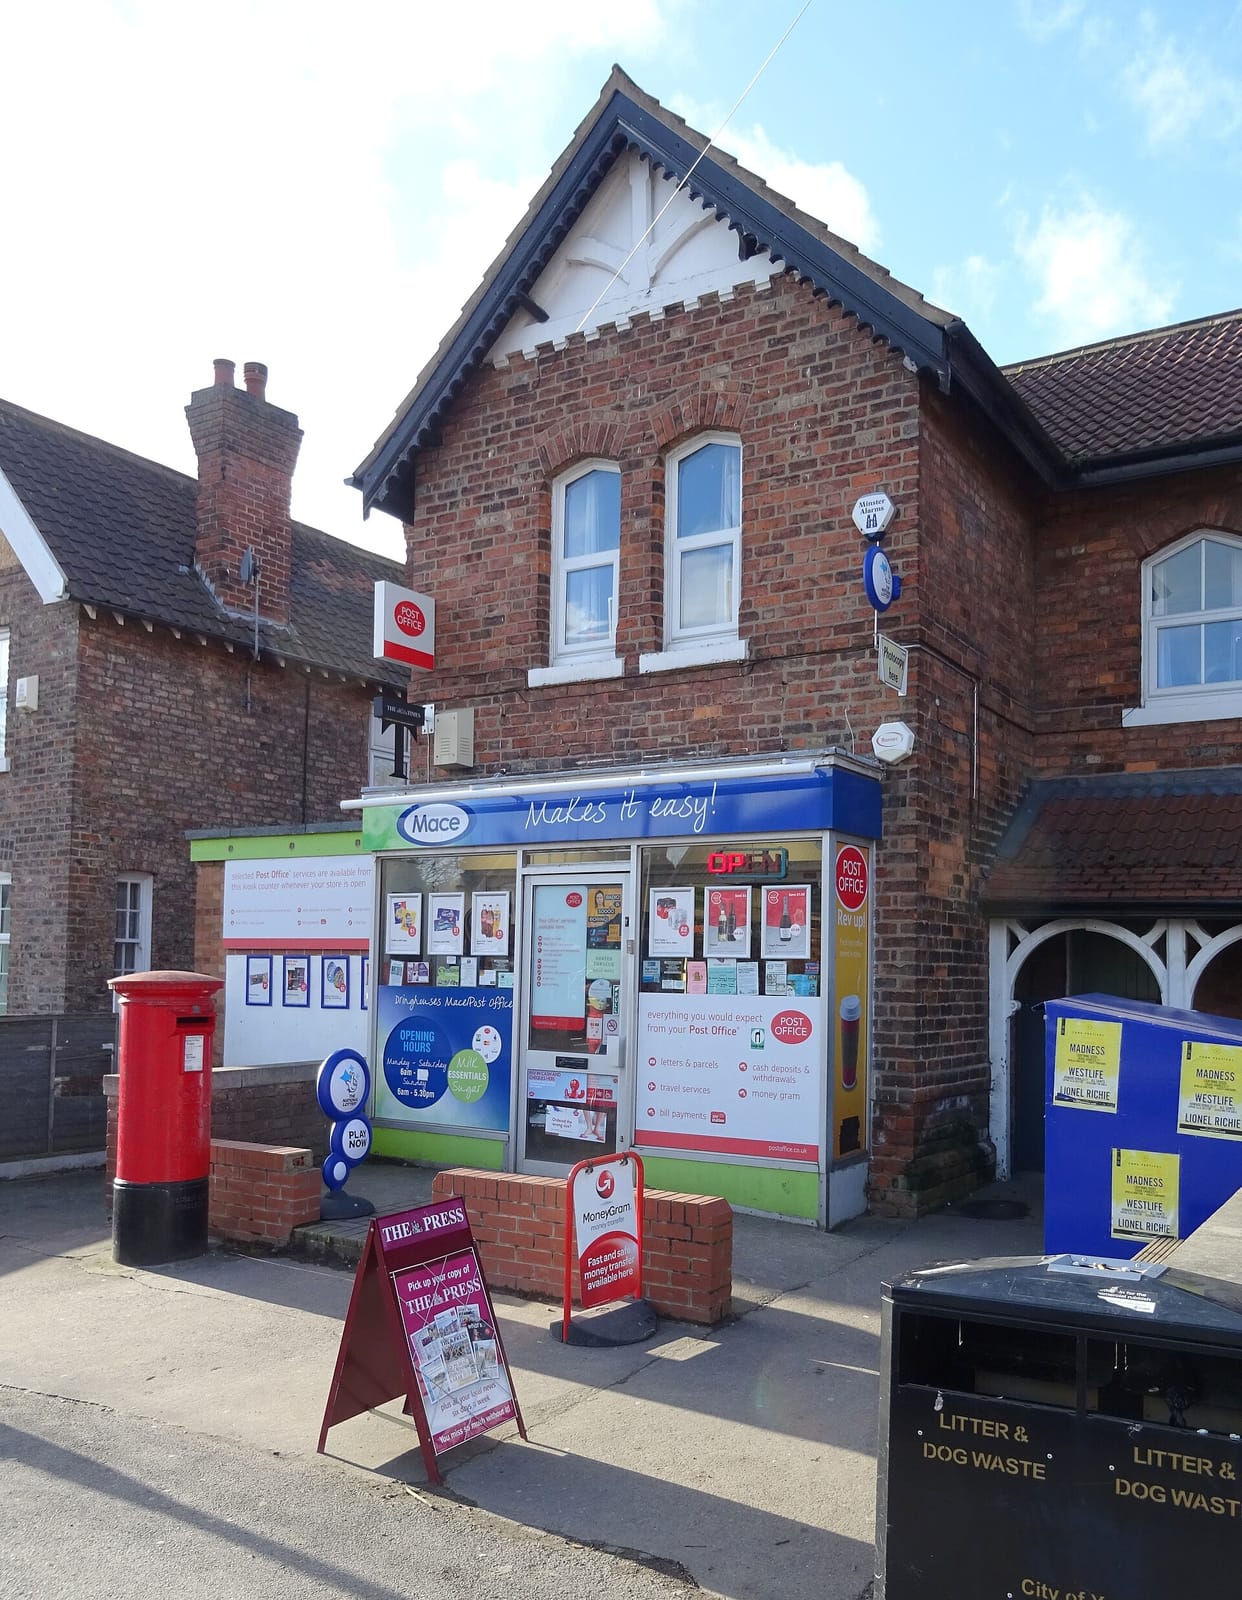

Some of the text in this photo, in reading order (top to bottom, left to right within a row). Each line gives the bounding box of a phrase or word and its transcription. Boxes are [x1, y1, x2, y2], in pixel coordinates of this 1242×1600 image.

[859, 499, 886, 508] Minster
[402, 606, 419, 620] POST
[397, 615, 422, 630] OFFICE
[889, 667, 898, 683] here
[525, 781, 717, 833] Makes it easy!
[411, 815, 461, 834] Mace
[707, 852, 781, 874] OPEN
[843, 859, 861, 877] POST
[255, 870, 269, 879] Post
[271, 869, 289, 879] Office
[293, 870, 316, 878] services
[329, 868, 356, 877] available
[258, 882, 280, 890] counter
[281, 881, 311, 889] whenever
[311, 881, 325, 890] your
[326, 880, 342, 888] store
[350, 880, 366, 889] open
[838, 876, 864, 894] OFFICE
[837, 909, 866, 932] Rev up!
[647, 1010, 763, 1023] everything you would expect
[780, 1017, 804, 1026] POST
[400, 1030, 435, 1042] OPENING
[647, 1023, 737, 1036] from your Post Office
[774, 1026, 807, 1037] OFFICE
[403, 1041, 431, 1053] HOURS
[1069, 1043, 1105, 1056] MADNESS
[387, 1058, 447, 1072] Monday Saturday
[456, 1057, 478, 1068] Milk
[660, 1058, 719, 1069] letters & parcels
[752, 1063, 810, 1075] cash deposits &
[447, 1070, 487, 1080] ESSENTIALS
[752, 1074, 796, 1084] withdrawals
[1068, 1066, 1104, 1080] WESTLIFE
[1196, 1068, 1235, 1082] MADNESS
[402, 1078, 427, 1089] Sunday
[452, 1081, 482, 1099] Sugar
[660, 1084, 711, 1094] travel services
[752, 1090, 800, 1101] money gram
[1060, 1086, 1110, 1100] LIONEL RICHIE
[1195, 1093, 1233, 1107] WESTLIFE
[660, 1109, 669, 1117] bill
[672, 1110, 707, 1120] payments
[1185, 1112, 1241, 1129] LIONEL RICHIE
[349, 1130, 366, 1139] PLAY
[349, 1139, 366, 1148] NOW
[768, 1144, 807, 1154] postoffice.co.uk
[1126, 1175, 1164, 1188] MADNESS
[1126, 1199, 1163, 1212] WESTLIFE
[582, 1202, 631, 1224] MoneyGram
[382, 1222, 411, 1243] THE
[423, 1207, 465, 1232] PRESS
[590, 1216, 625, 1231] money transfer
[1118, 1218, 1171, 1234] LIONEL RICHIE
[587, 1255, 603, 1267] Fast
[603, 1249, 617, 1263] and
[584, 1256, 635, 1280] money transfer
[408, 1263, 470, 1292] Pick up your copy of
[587, 1268, 634, 1290] available here
[406, 1278, 481, 1315] THE PRESS
[440, 1402, 452, 1412] plus
[460, 1393, 470, 1404] your
[471, 1387, 482, 1397] local
[483, 1382, 497, 1392] news
[460, 1405, 472, 1414] days
[477, 1396, 490, 1406] week
[439, 1435, 450, 1443] You
[450, 1428, 463, 1438] miss
[471, 1417, 486, 1429] much
[486, 1408, 505, 1421] without
[939, 1412, 1029, 1443] LITTER &
[923, 1442, 1047, 1481] DOG WASTE
[1133, 1446, 1236, 1481] LITTER &
[1115, 1477, 1242, 1518] DOG WAST
[1020, 1578, 1060, 1600] City
